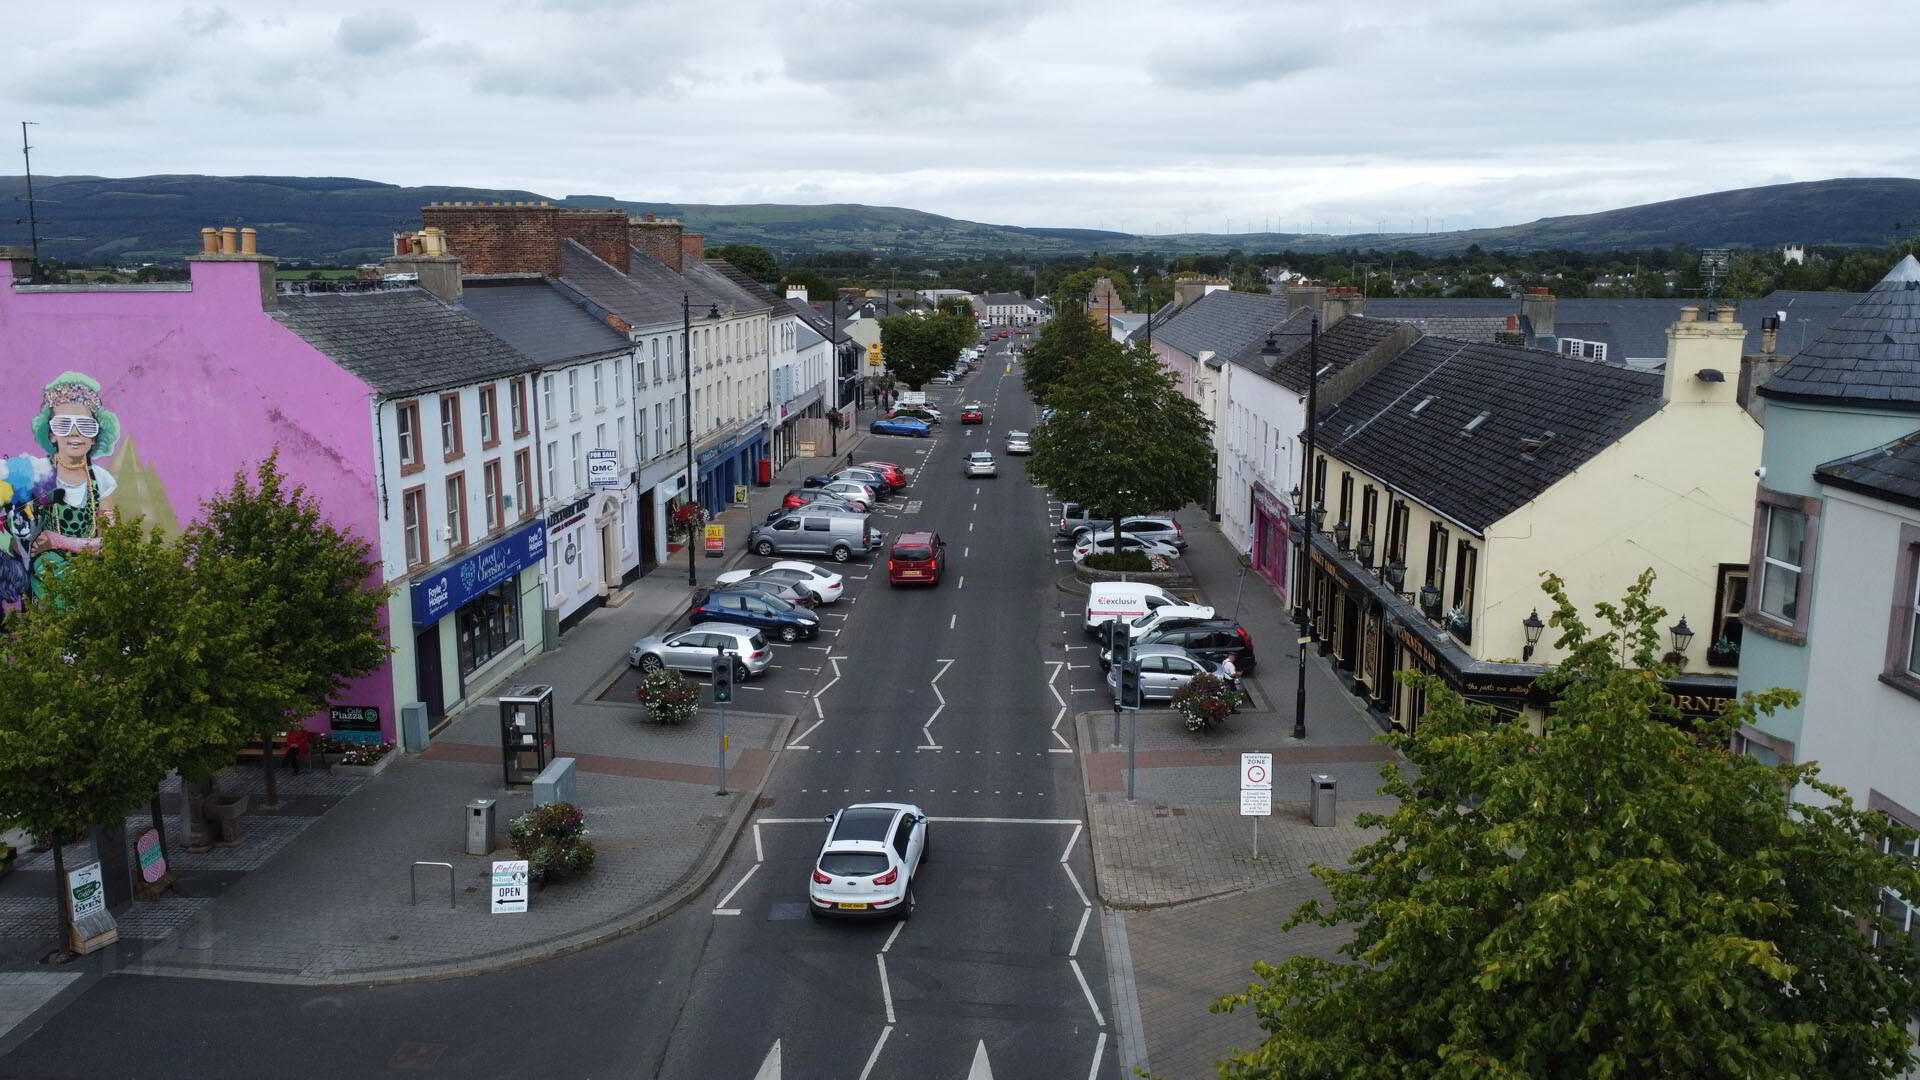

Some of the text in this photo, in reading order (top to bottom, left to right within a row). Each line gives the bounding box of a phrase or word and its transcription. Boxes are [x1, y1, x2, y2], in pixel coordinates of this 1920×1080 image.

[592, 464, 613, 472] DMC
[707, 528, 721, 537] SALE
[529, 533, 539, 543] Foyle
[529, 540, 542, 552] Hospice
[428, 585, 441, 599] Foyle
[428, 591, 448, 608] Hospice
[1106, 597, 1137, 605] exclusiv
[331, 711, 364, 720] Piazza
[494, 862, 525, 873] Coffee
[499, 887, 521, 897] OPEN
[75, 898, 102, 913] OPEN
